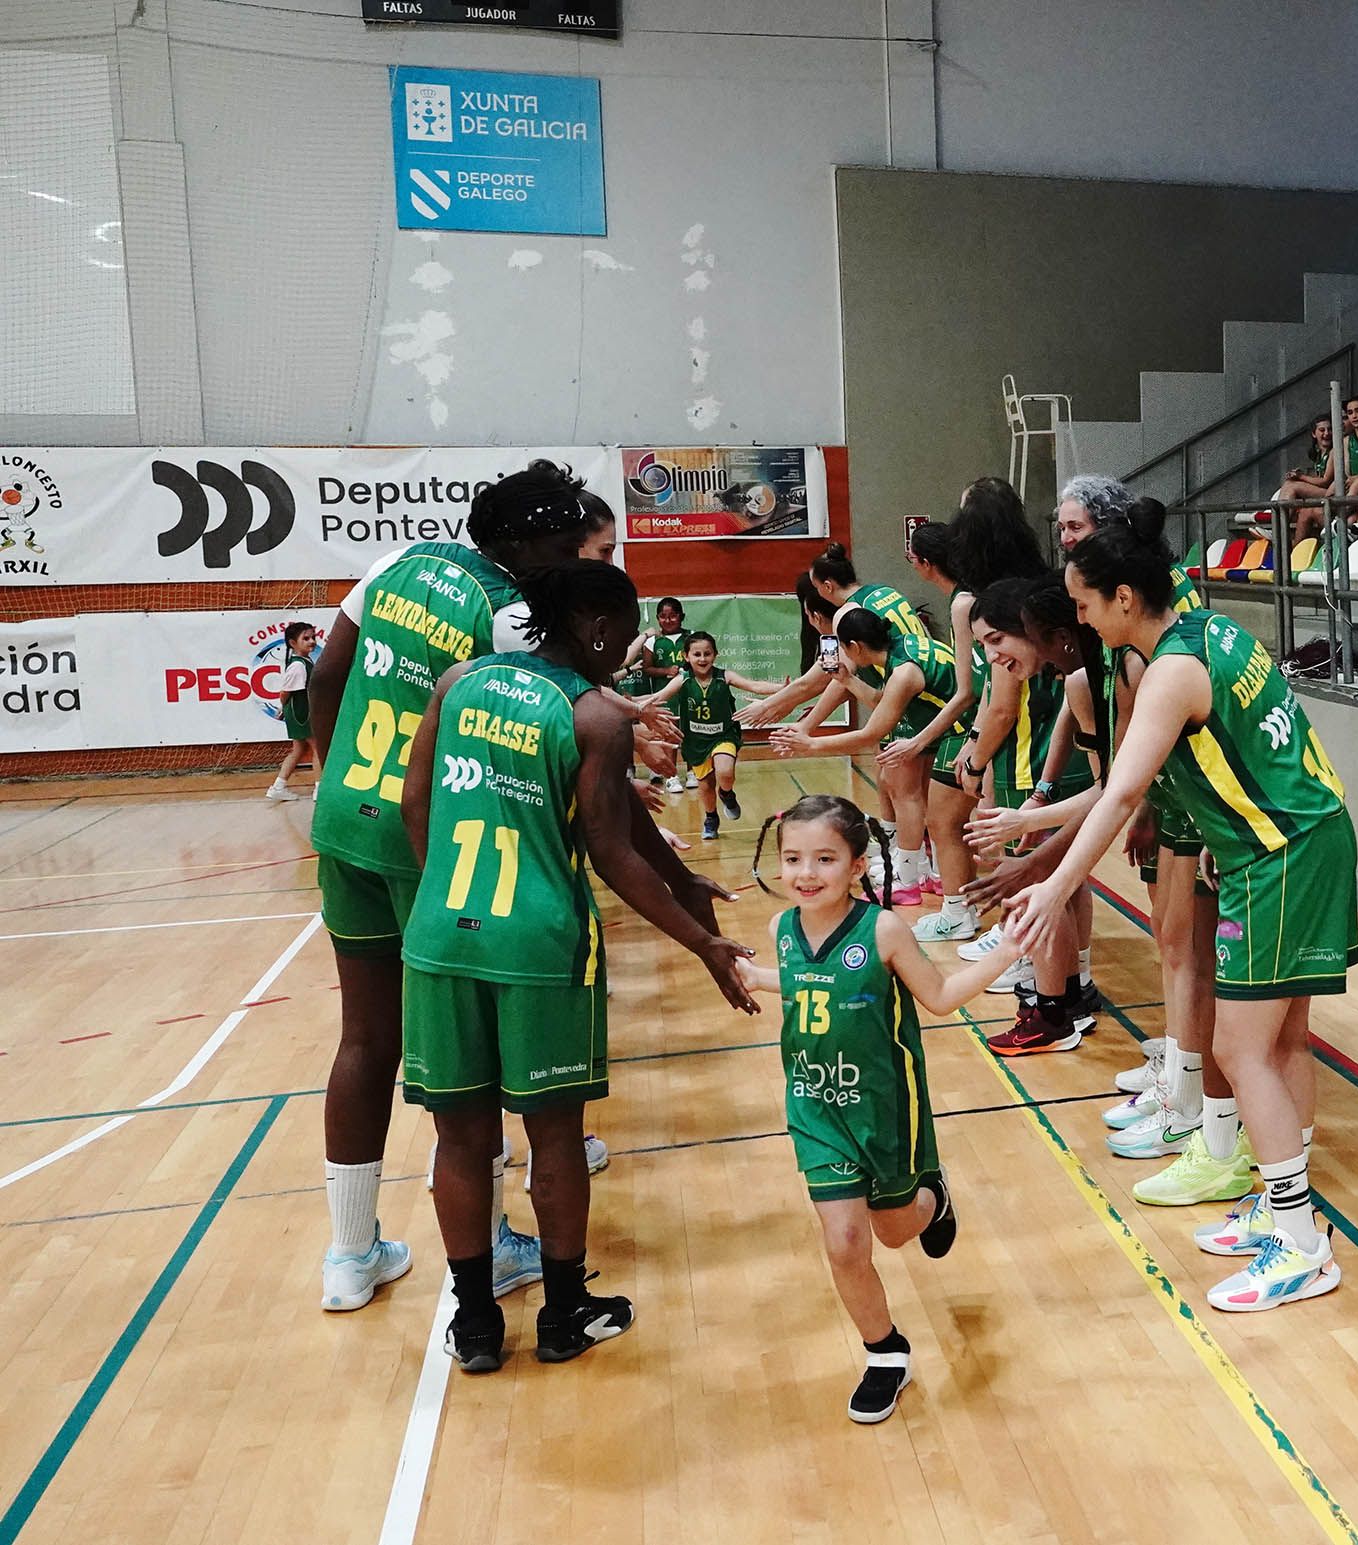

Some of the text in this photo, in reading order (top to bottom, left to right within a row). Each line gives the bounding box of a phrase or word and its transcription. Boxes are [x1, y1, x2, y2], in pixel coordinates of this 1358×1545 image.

[383, 1, 423, 14] FALTAS
[465, 7, 517, 20] JUGADOR
[557, 13, 596, 26] FALTAS
[459, 91, 539, 114] XUNTA
[460, 116, 588, 141] DE GALICIA
[457, 171, 536, 187] DEPORTE
[458, 187, 528, 202] GALEGO
[0, 455, 63, 509] LONCESTO
[318, 473, 505, 514] Deputac
[321, 514, 464, 541] Pontev
[652, 517, 682, 527] Kodak
[0, 559, 49, 576] RXIL
[416, 569, 469, 607] ABANCA
[0, 642, 78, 676] ión
[740, 647, 791, 657] Pontevedra
[164, 665, 282, 703] PESC
[483, 678, 542, 706] ABANCA
[695, 706, 711, 721] 13
[458, 707, 543, 757] CHASSÉ
[446, 819, 520, 918] 11
[795, 989, 831, 1035] 13
[1273, 1179, 1294, 1190] NIKE
